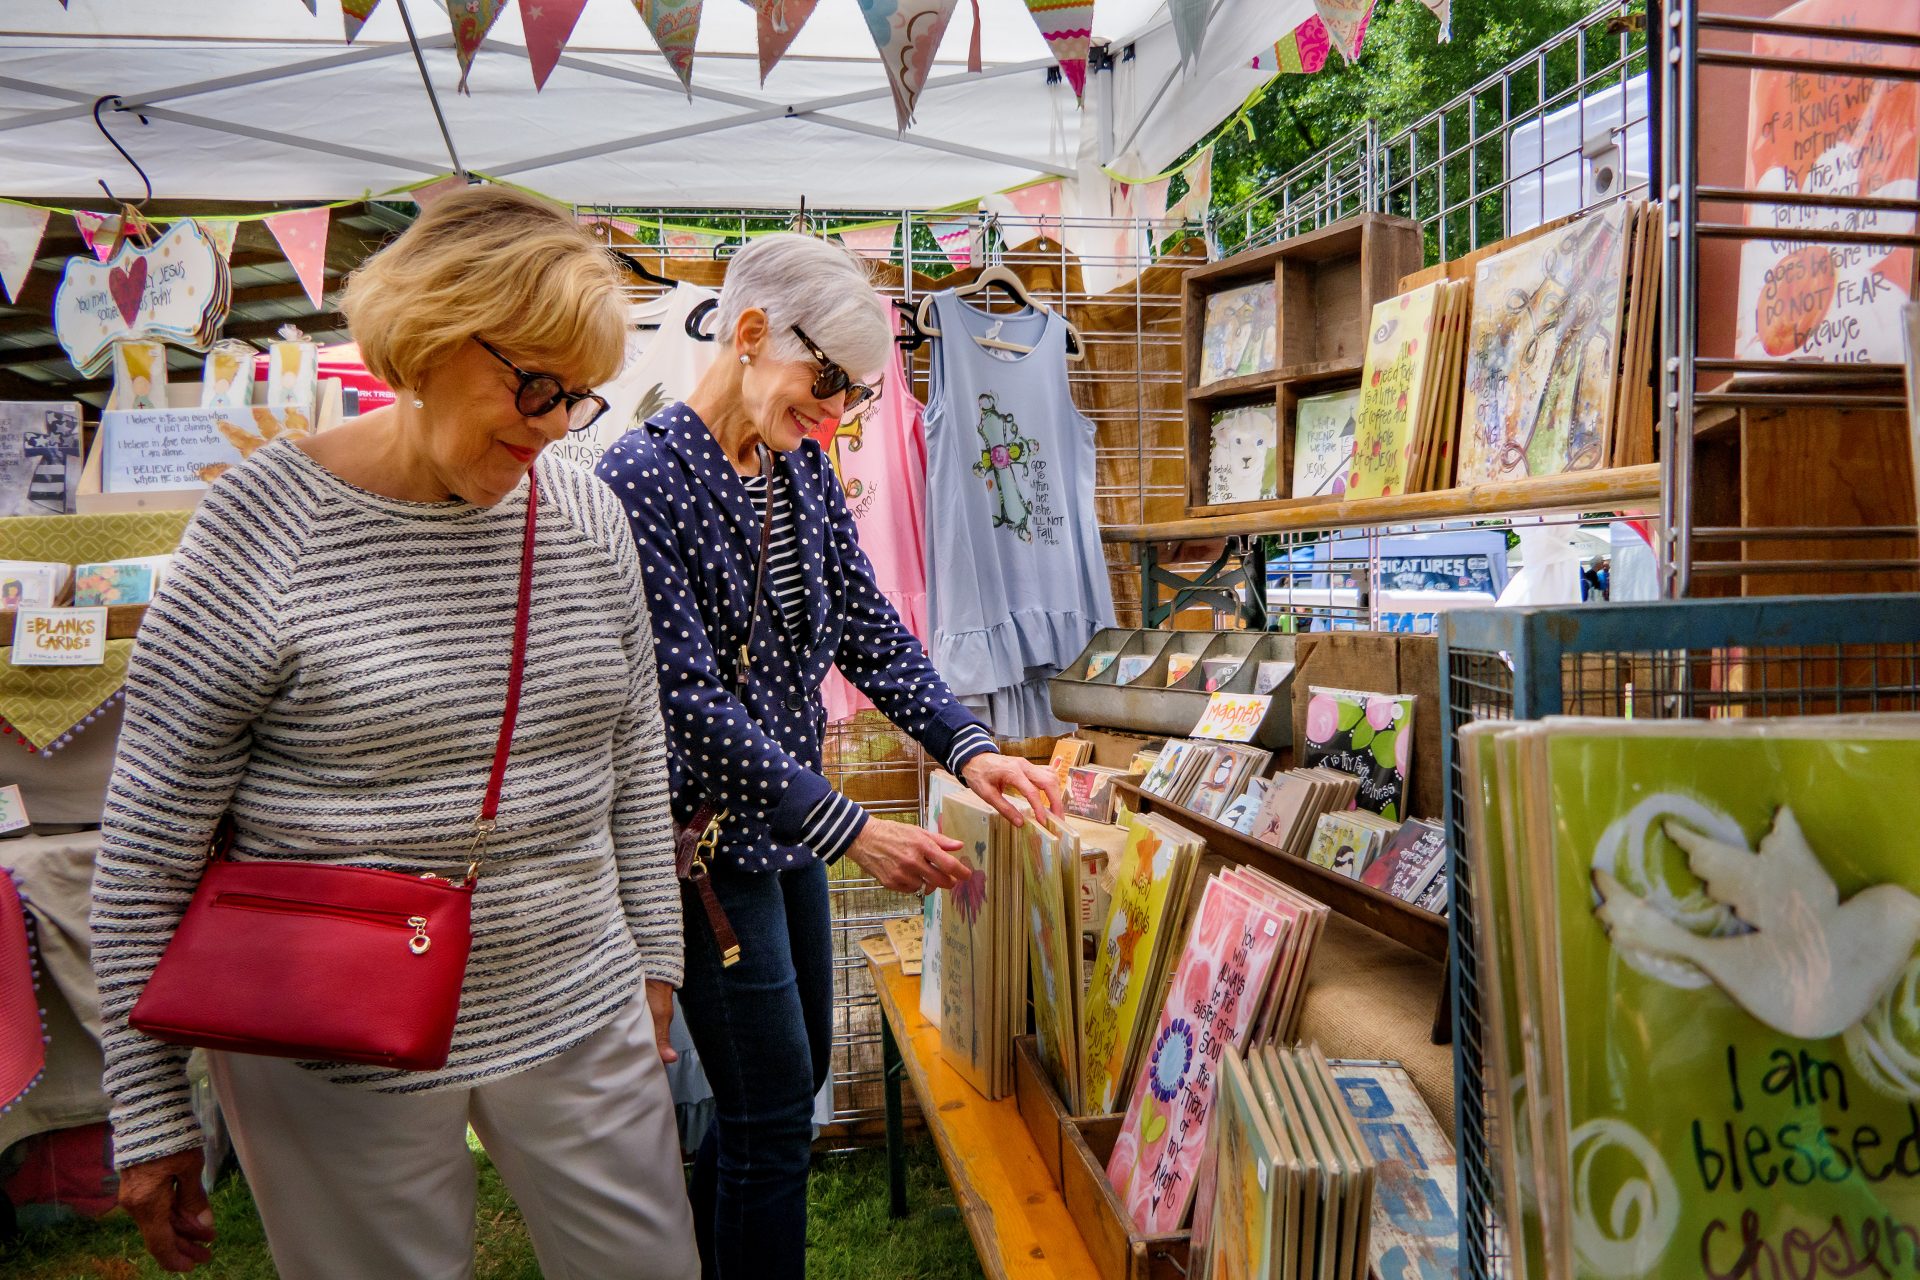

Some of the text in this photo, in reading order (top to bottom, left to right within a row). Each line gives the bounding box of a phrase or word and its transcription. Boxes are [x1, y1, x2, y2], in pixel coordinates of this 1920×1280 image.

[1762, 112, 1779, 143] of
[1783, 111, 1793, 131] a
[1799, 94, 1840, 132] KING
[1794, 130, 1822, 161] not
[1807, 161, 1833, 193] the
[1845, 208, 1878, 232] and
[159, 260, 186, 284] JESUS
[1764, 260, 1806, 300] goes
[1811, 246, 1861, 278] before
[1766, 299, 1785, 326] DO
[1789, 286, 1830, 317] NOT
[1837, 271, 1891, 308] FEAR
[1793, 316, 1861, 354] because
[131, 414, 157, 424] believe
[208, 411, 229, 422] when
[1368, 408, 1392, 430] coffee
[123, 439, 150, 449] believe
[199, 435, 220, 444] when
[1308, 429, 1335, 443] FRIEND
[1474, 423, 1498, 448] KING
[133, 464, 174, 474] BELIEVE
[1031, 460, 1047, 472] GOD
[134, 475, 158, 485] when
[1047, 516, 1064, 526] NOT
[35, 617, 96, 636] BLANKS
[36, 633, 83, 651] CARDS
[1207, 700, 1265, 731] Magnets
[1241, 924, 1256, 949] You
[1232, 947, 1248, 967] will
[1217, 962, 1246, 996] ALWAYS
[1211, 983, 1235, 1014] be the
[1193, 999, 1218, 1029] sister
[1217, 1018, 1229, 1040] of
[1195, 1061, 1211, 1092] the
[1726, 1044, 1849, 1112] I am
[1180, 1082, 1208, 1126] friend
[1179, 1118, 1192, 1143] of
[1691, 1100, 1920, 1193] blessed
